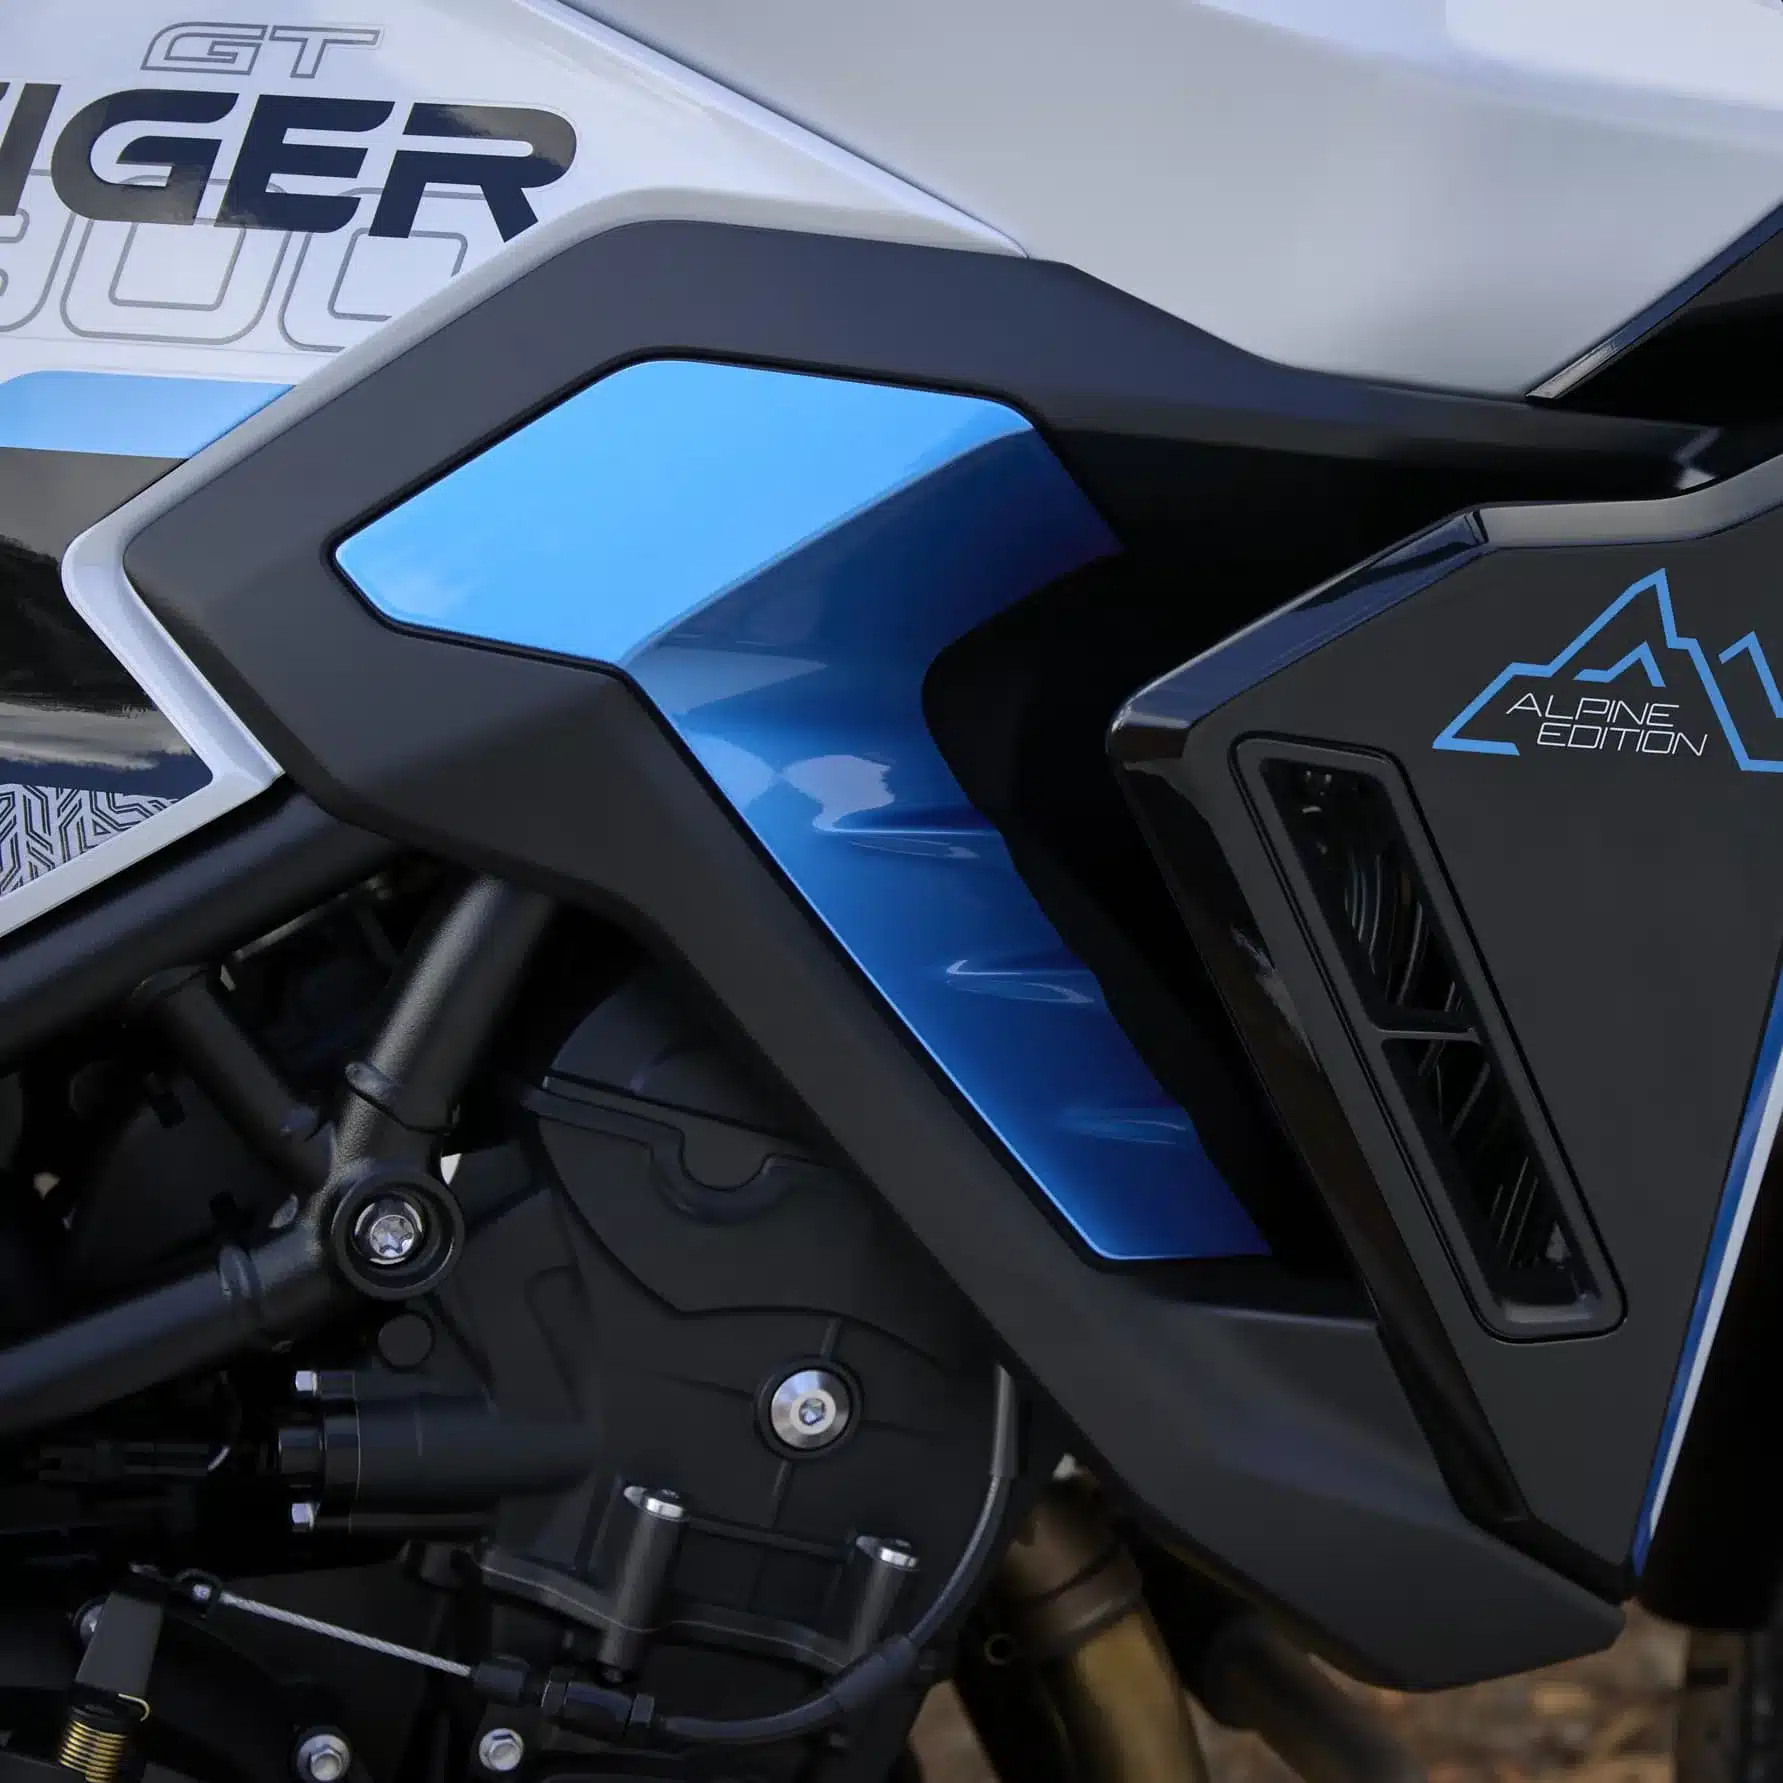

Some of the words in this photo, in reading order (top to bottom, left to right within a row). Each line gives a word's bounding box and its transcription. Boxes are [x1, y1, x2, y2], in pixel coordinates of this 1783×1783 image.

[140, 21, 380, 79] GT
[0, 82, 578, 243] IGER
[1506, 692, 1680, 727] ALPINE
[1536, 722, 1708, 757] EDITION
